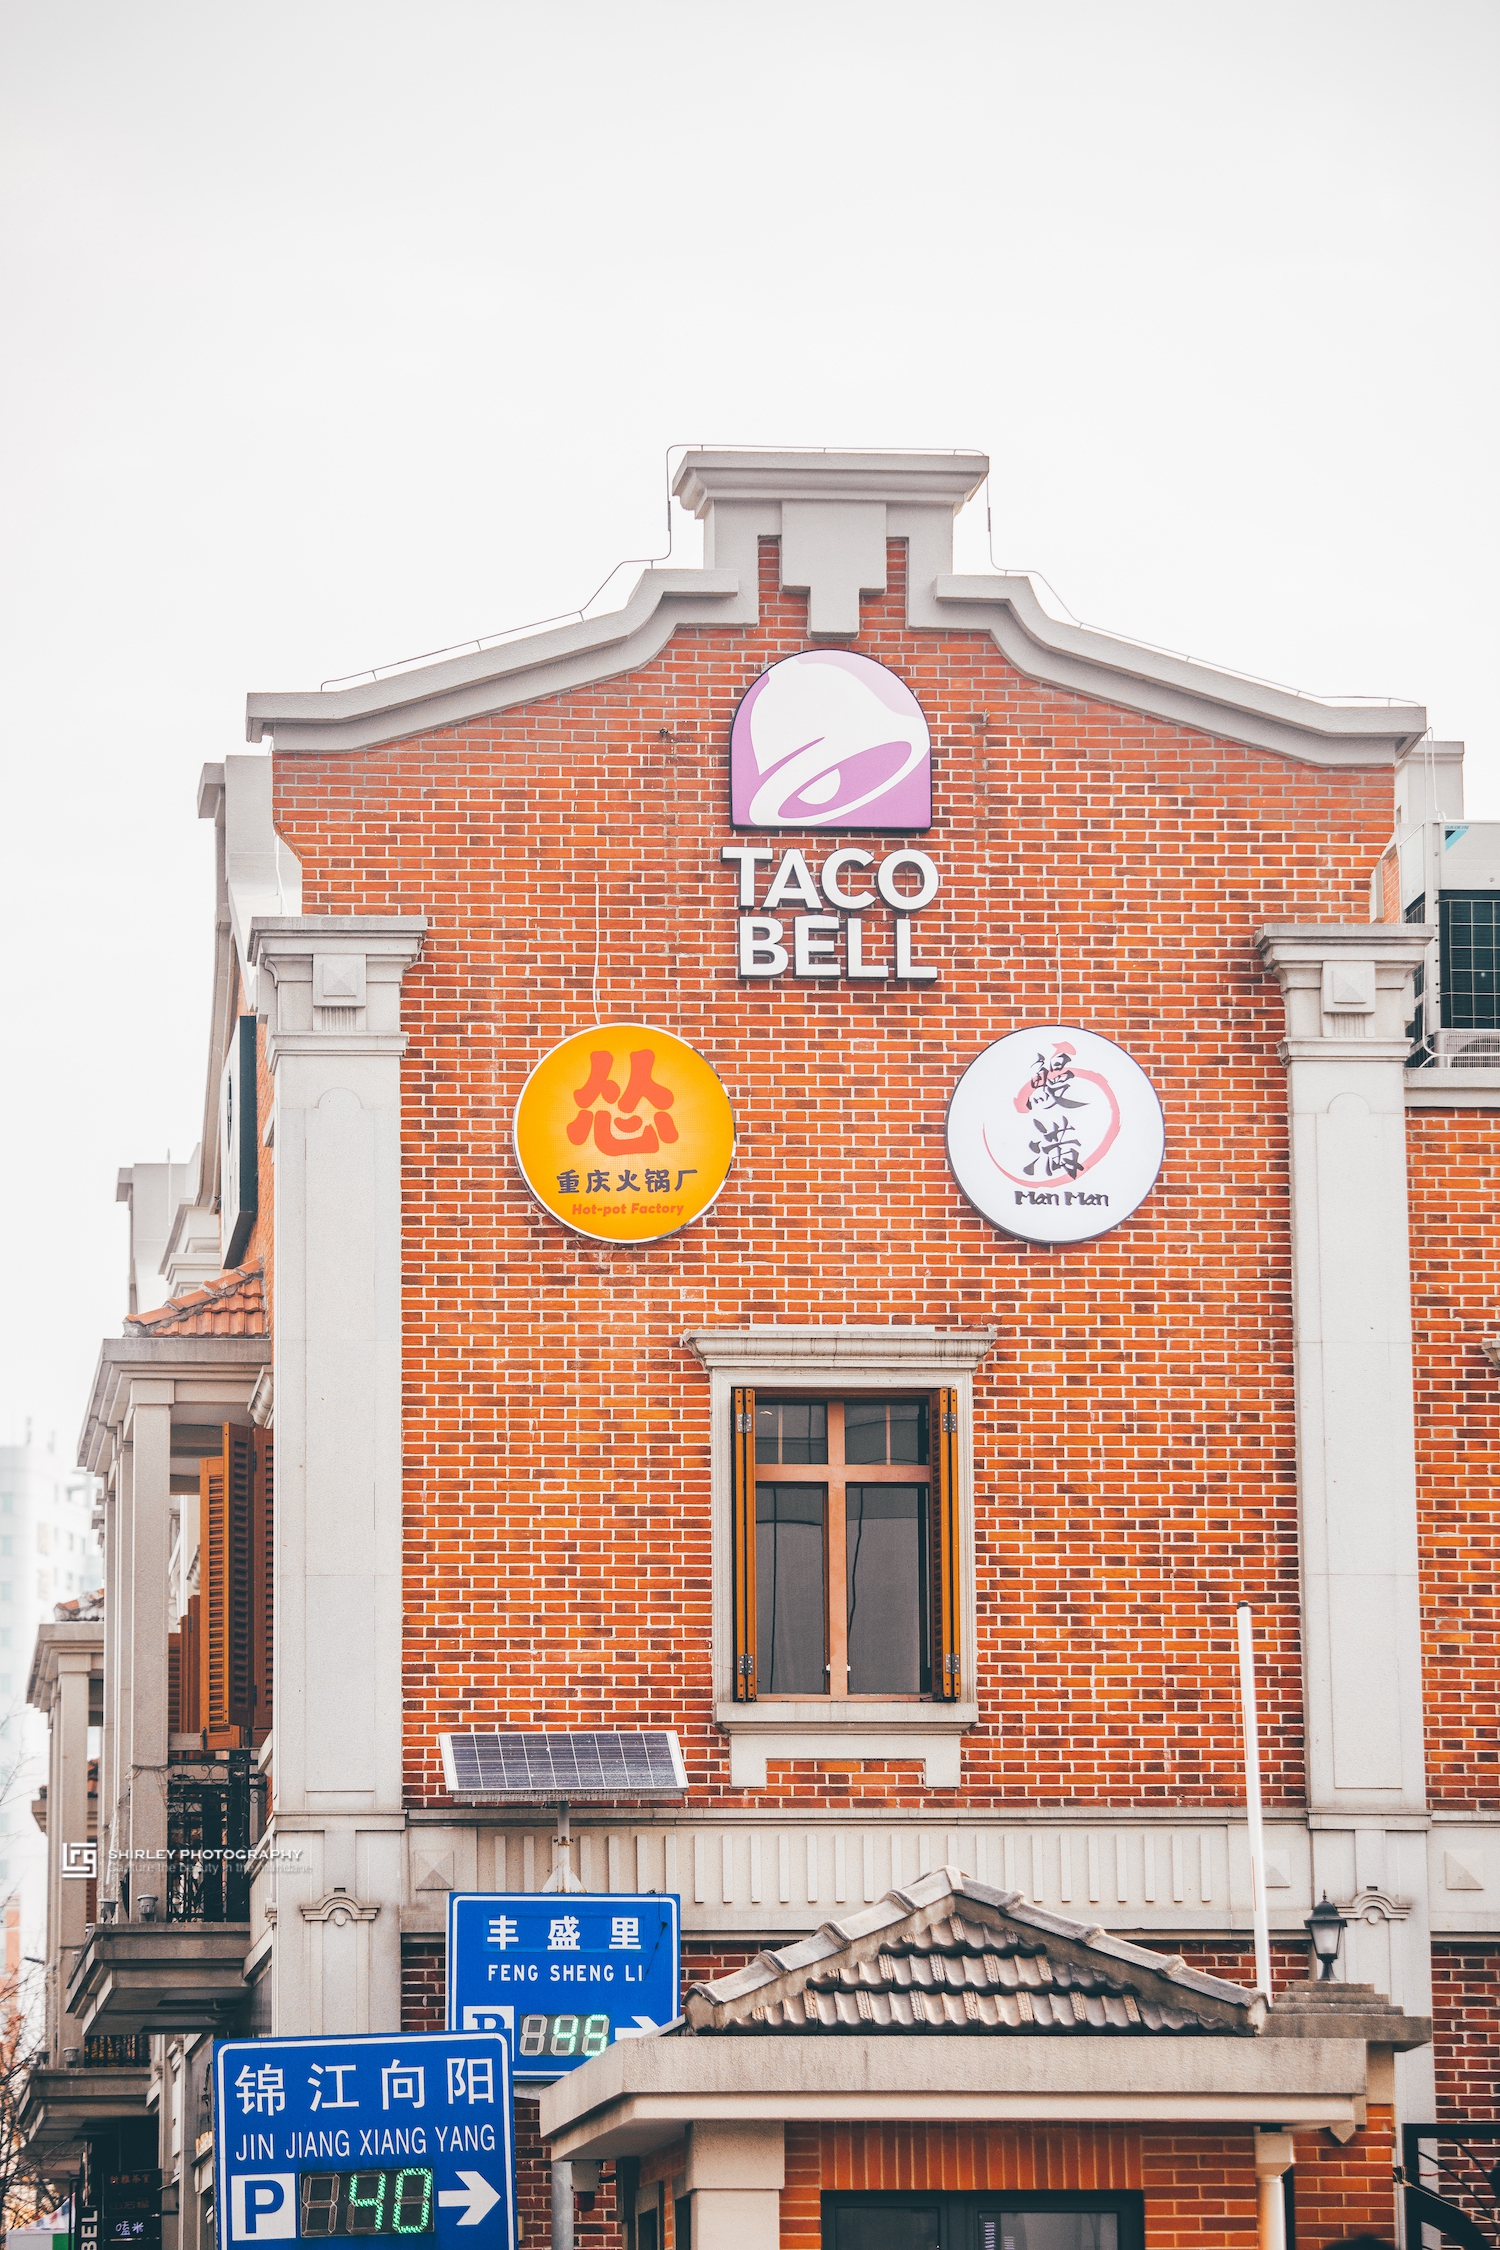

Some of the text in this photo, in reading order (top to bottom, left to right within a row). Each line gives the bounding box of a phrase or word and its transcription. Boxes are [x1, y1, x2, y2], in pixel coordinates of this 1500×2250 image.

[721, 846, 939, 912] TACO
[738, 914, 938, 981] BELL
[566, 1049, 679, 1157] 怂
[557, 1168, 698, 1194] 重庆火锅厂
[1014, 1190, 1109, 1207] Man Man
[572, 1202, 684, 1217] Hot-pot Factory
[487, 1915, 642, 1951] 丰盛里
[488, 1964, 643, 1982] FENG SHENG LI
[234, 2057, 495, 2117] 锦江向阳
[235, 2123, 495, 2161] JIN JIANG XIANG YANG
[244, 2167, 433, 2234] P 40
